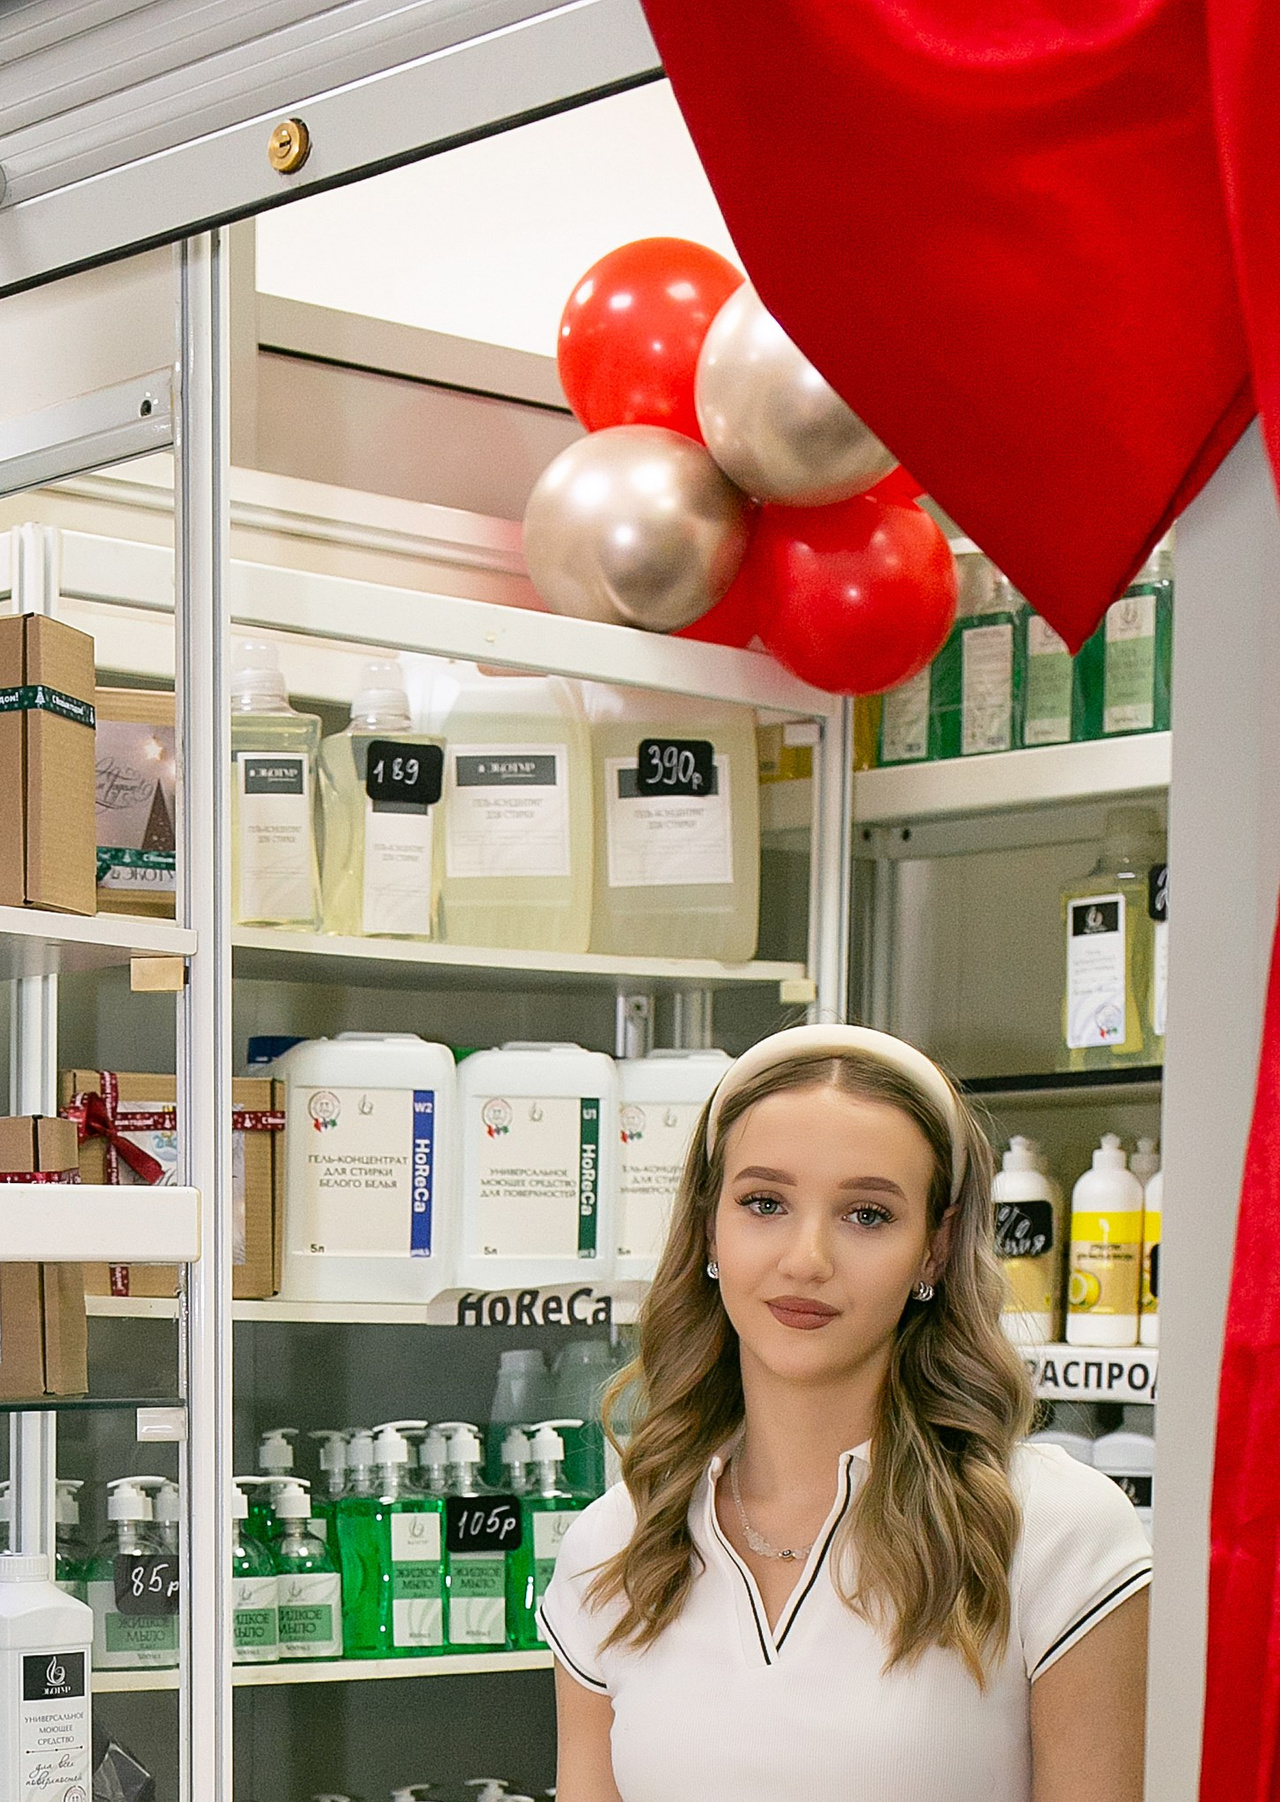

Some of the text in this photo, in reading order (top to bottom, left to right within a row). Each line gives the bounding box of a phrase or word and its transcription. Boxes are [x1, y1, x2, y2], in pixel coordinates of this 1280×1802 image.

[372, 757, 420, 785] 189
[308, 1154, 408, 1165] ГЕЛЬ-КОНЦЕНТРАТ
[323, 1167, 393, 1177] ДЛЯ СТИРКИ
[413, 1138, 431, 1214] HoReCa
[320, 1178, 398, 1189] БЕЛОГО БЕЛЬЯ
[580, 1143, 596, 1217] HoReCa
[310, 1243, 325, 1254] 5л
[457, 1286, 613, 1327] HoReCa
[458, 1505, 517, 1540] 105р
[131, 1563, 179, 1597] 85р
[233, 1613, 271, 1624] ИДКОЕ
[24, 1711, 84, 1724] УНИВЕРСАЛЬНОЕ
[39, 1724, 73, 1734] МОЮЩЕЕ
[37, 1735, 75, 1746] СРЕДСТВО
